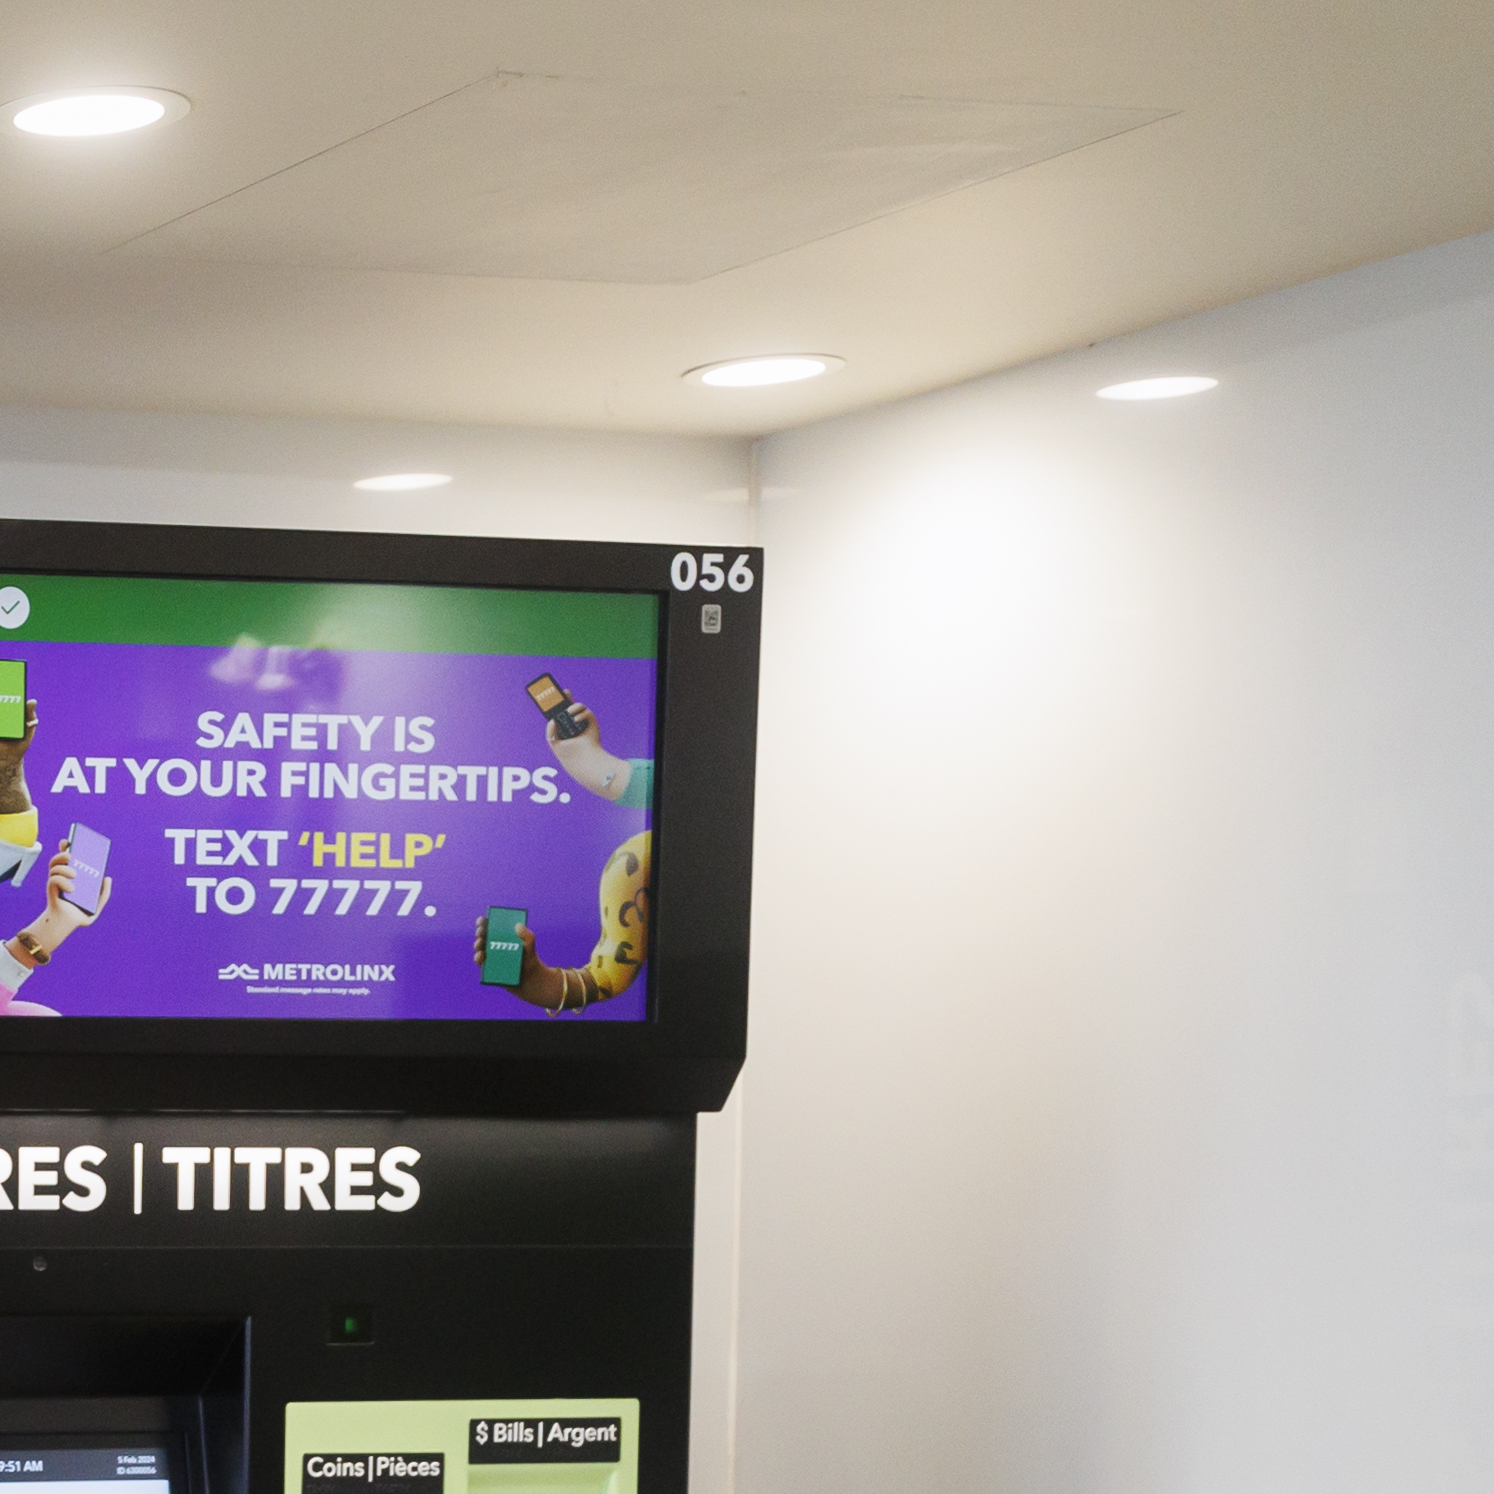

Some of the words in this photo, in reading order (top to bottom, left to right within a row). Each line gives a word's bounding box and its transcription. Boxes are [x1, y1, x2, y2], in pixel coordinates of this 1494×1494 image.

[670, 551, 754, 593] 056
[195, 711, 386, 752] SAFETY
[393, 715, 435, 754] IS
[50, 756, 117, 794] AT
[122, 758, 267, 798] YOUR
[280, 761, 571, 804] FINGERTIPS.
[164, 828, 289, 867] TEXT
[185, 876, 256, 915] TO
[269, 878, 437, 917] 77777.
[263, 963, 396, 982] METROLINX
[161, 1145, 421, 1212] TITRES
[493, 1421, 535, 1443] Bills
[546, 1421, 618, 1448] Argent
[23, 1460, 44, 1472] AM
[306, 1456, 365, 1478] Coins
[376, 1455, 441, 1477] Pièces
